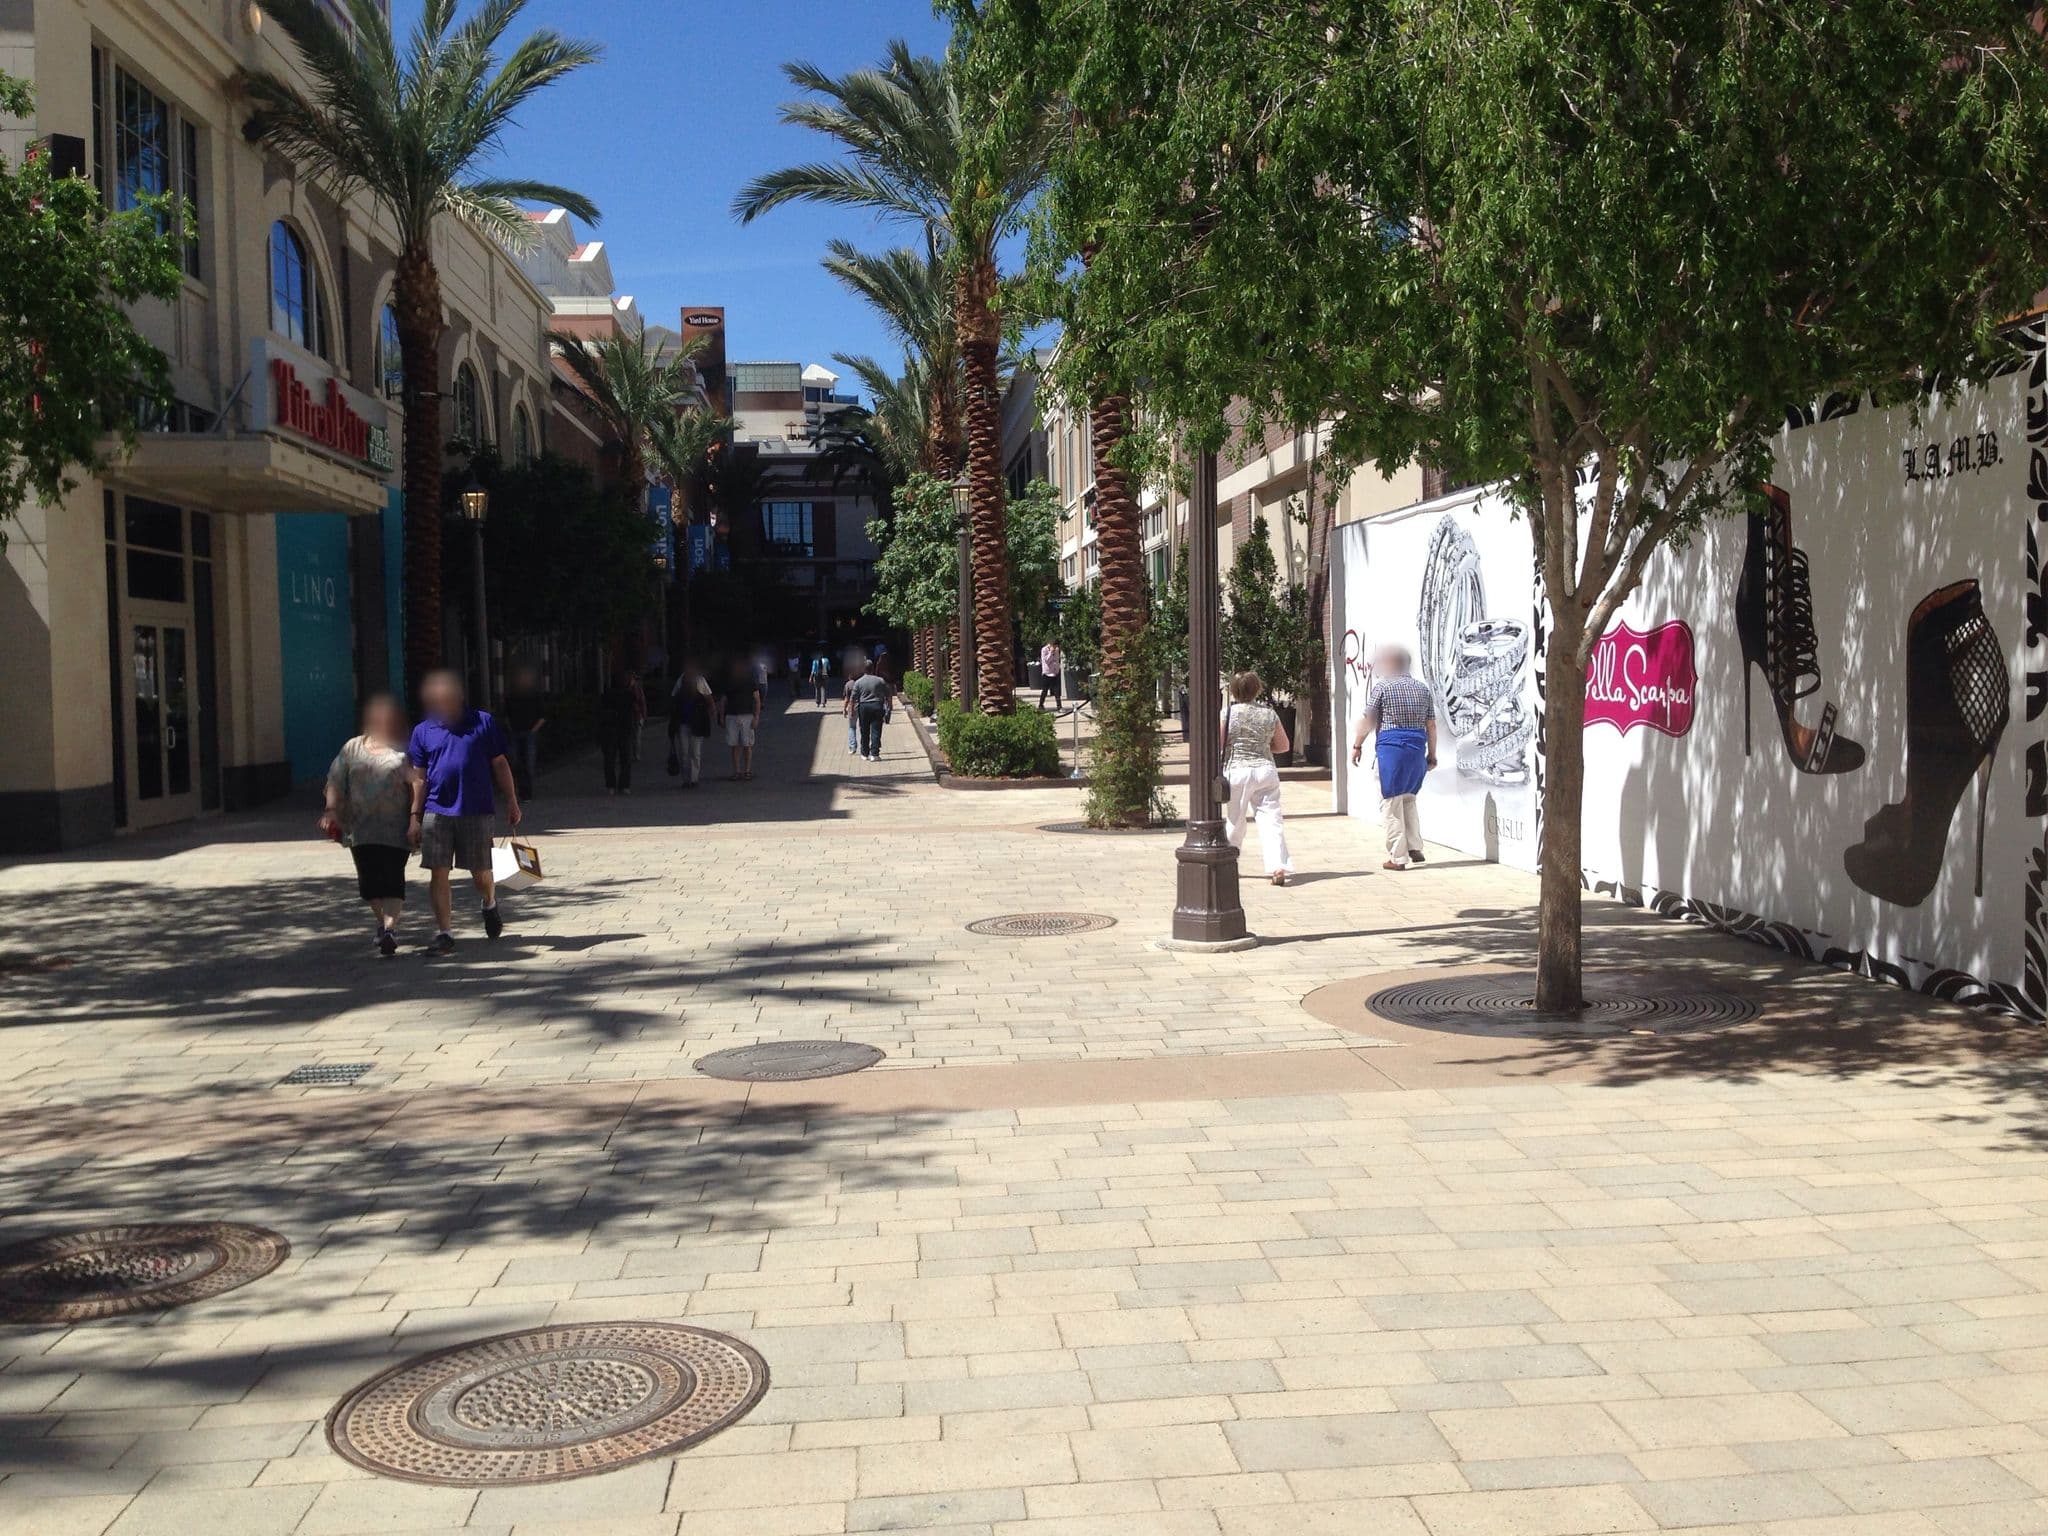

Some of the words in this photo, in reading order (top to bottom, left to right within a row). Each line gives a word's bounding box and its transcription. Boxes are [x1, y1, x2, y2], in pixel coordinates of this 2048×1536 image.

[689, 316, 702, 324] Yard
[702, 316, 719, 324] House
[1902, 430, 2004, 487] L.A.M.B.
[291, 569, 337, 608] LINQ
[1623, 644, 1690, 728] Scarpa
[1488, 815, 1523, 841] CRISLU
